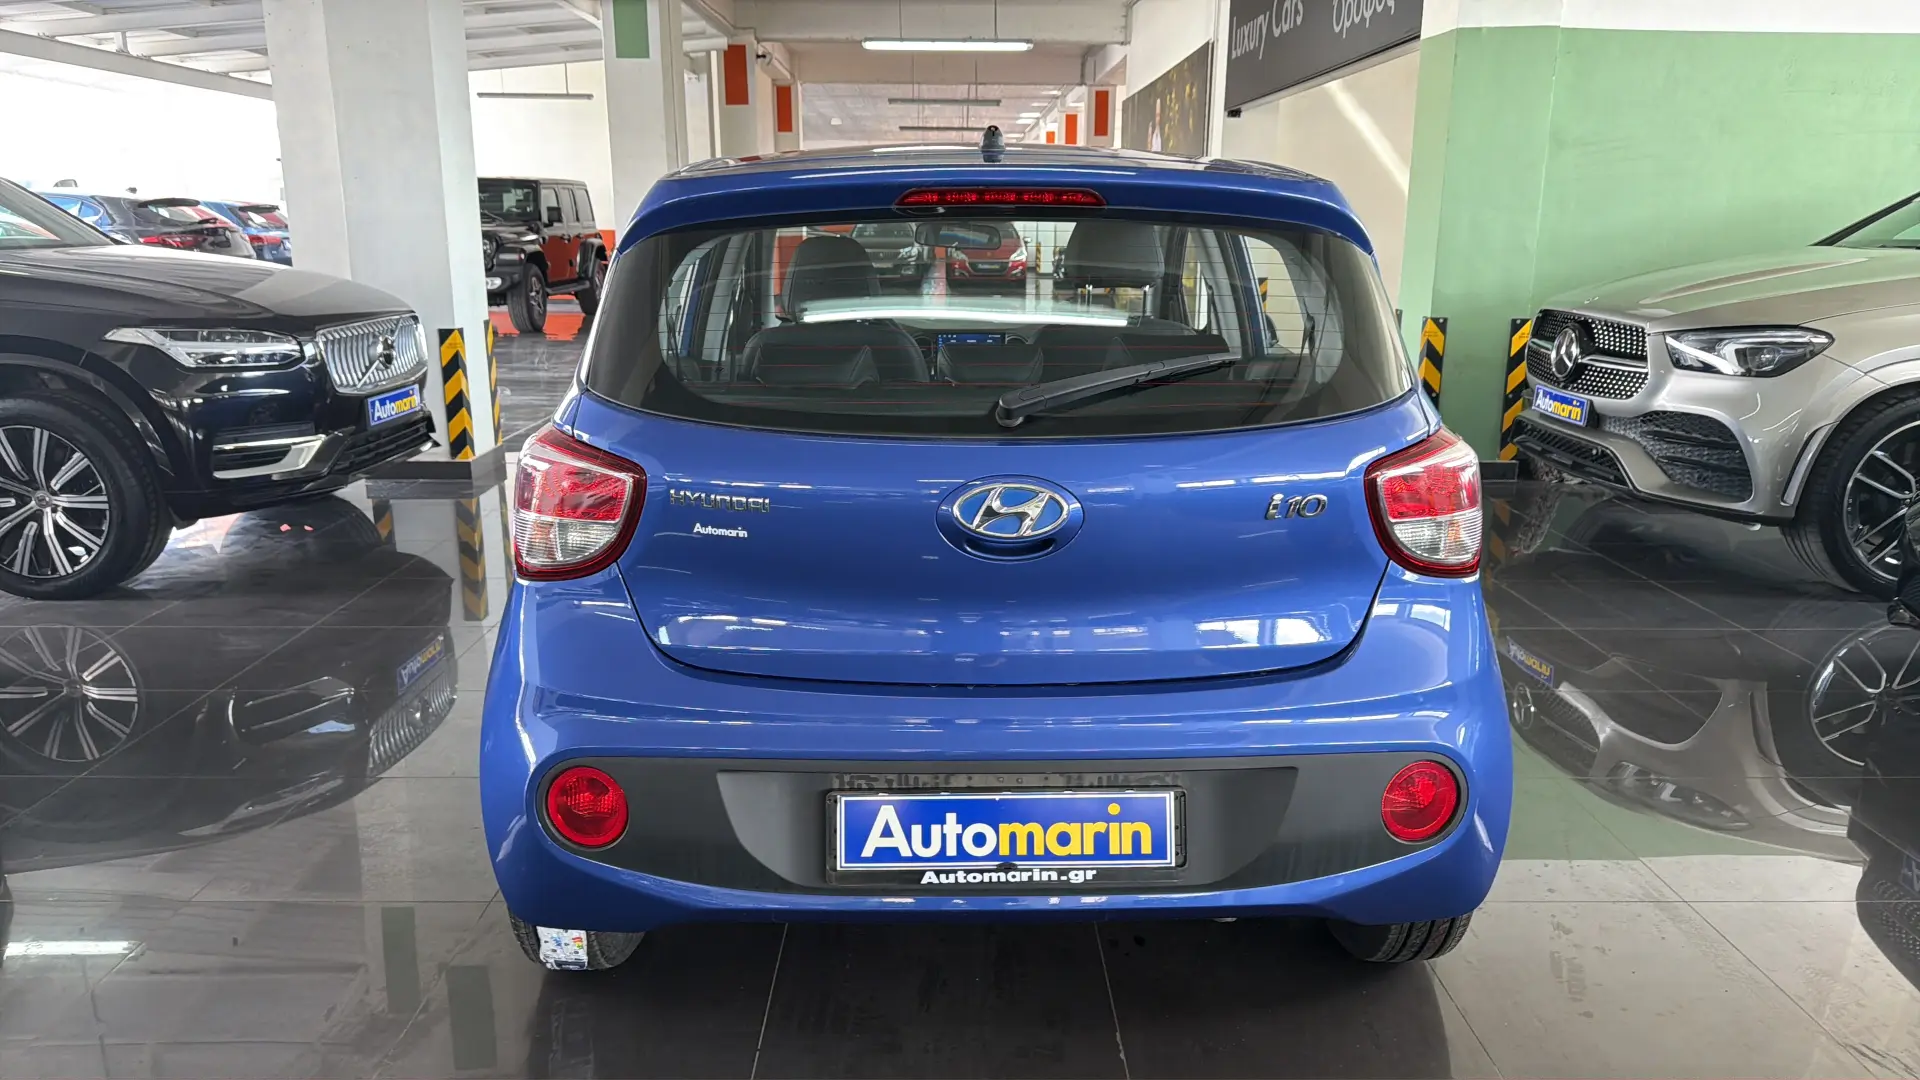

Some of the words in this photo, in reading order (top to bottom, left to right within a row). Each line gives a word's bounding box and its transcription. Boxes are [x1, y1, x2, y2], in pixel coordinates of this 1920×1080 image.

[1232, 12, 1269, 60] Luxury
[1272, 0, 1303, 37] Cars
[1535, 389, 1582, 421] Automarin
[669, 489, 770, 513] HYUNDAI
[1265, 493, 1328, 520] i10
[693, 523, 748, 538] Automarin
[860, 803, 1152, 858] Automarin
[920, 868, 1097, 885] Automarin.gr
